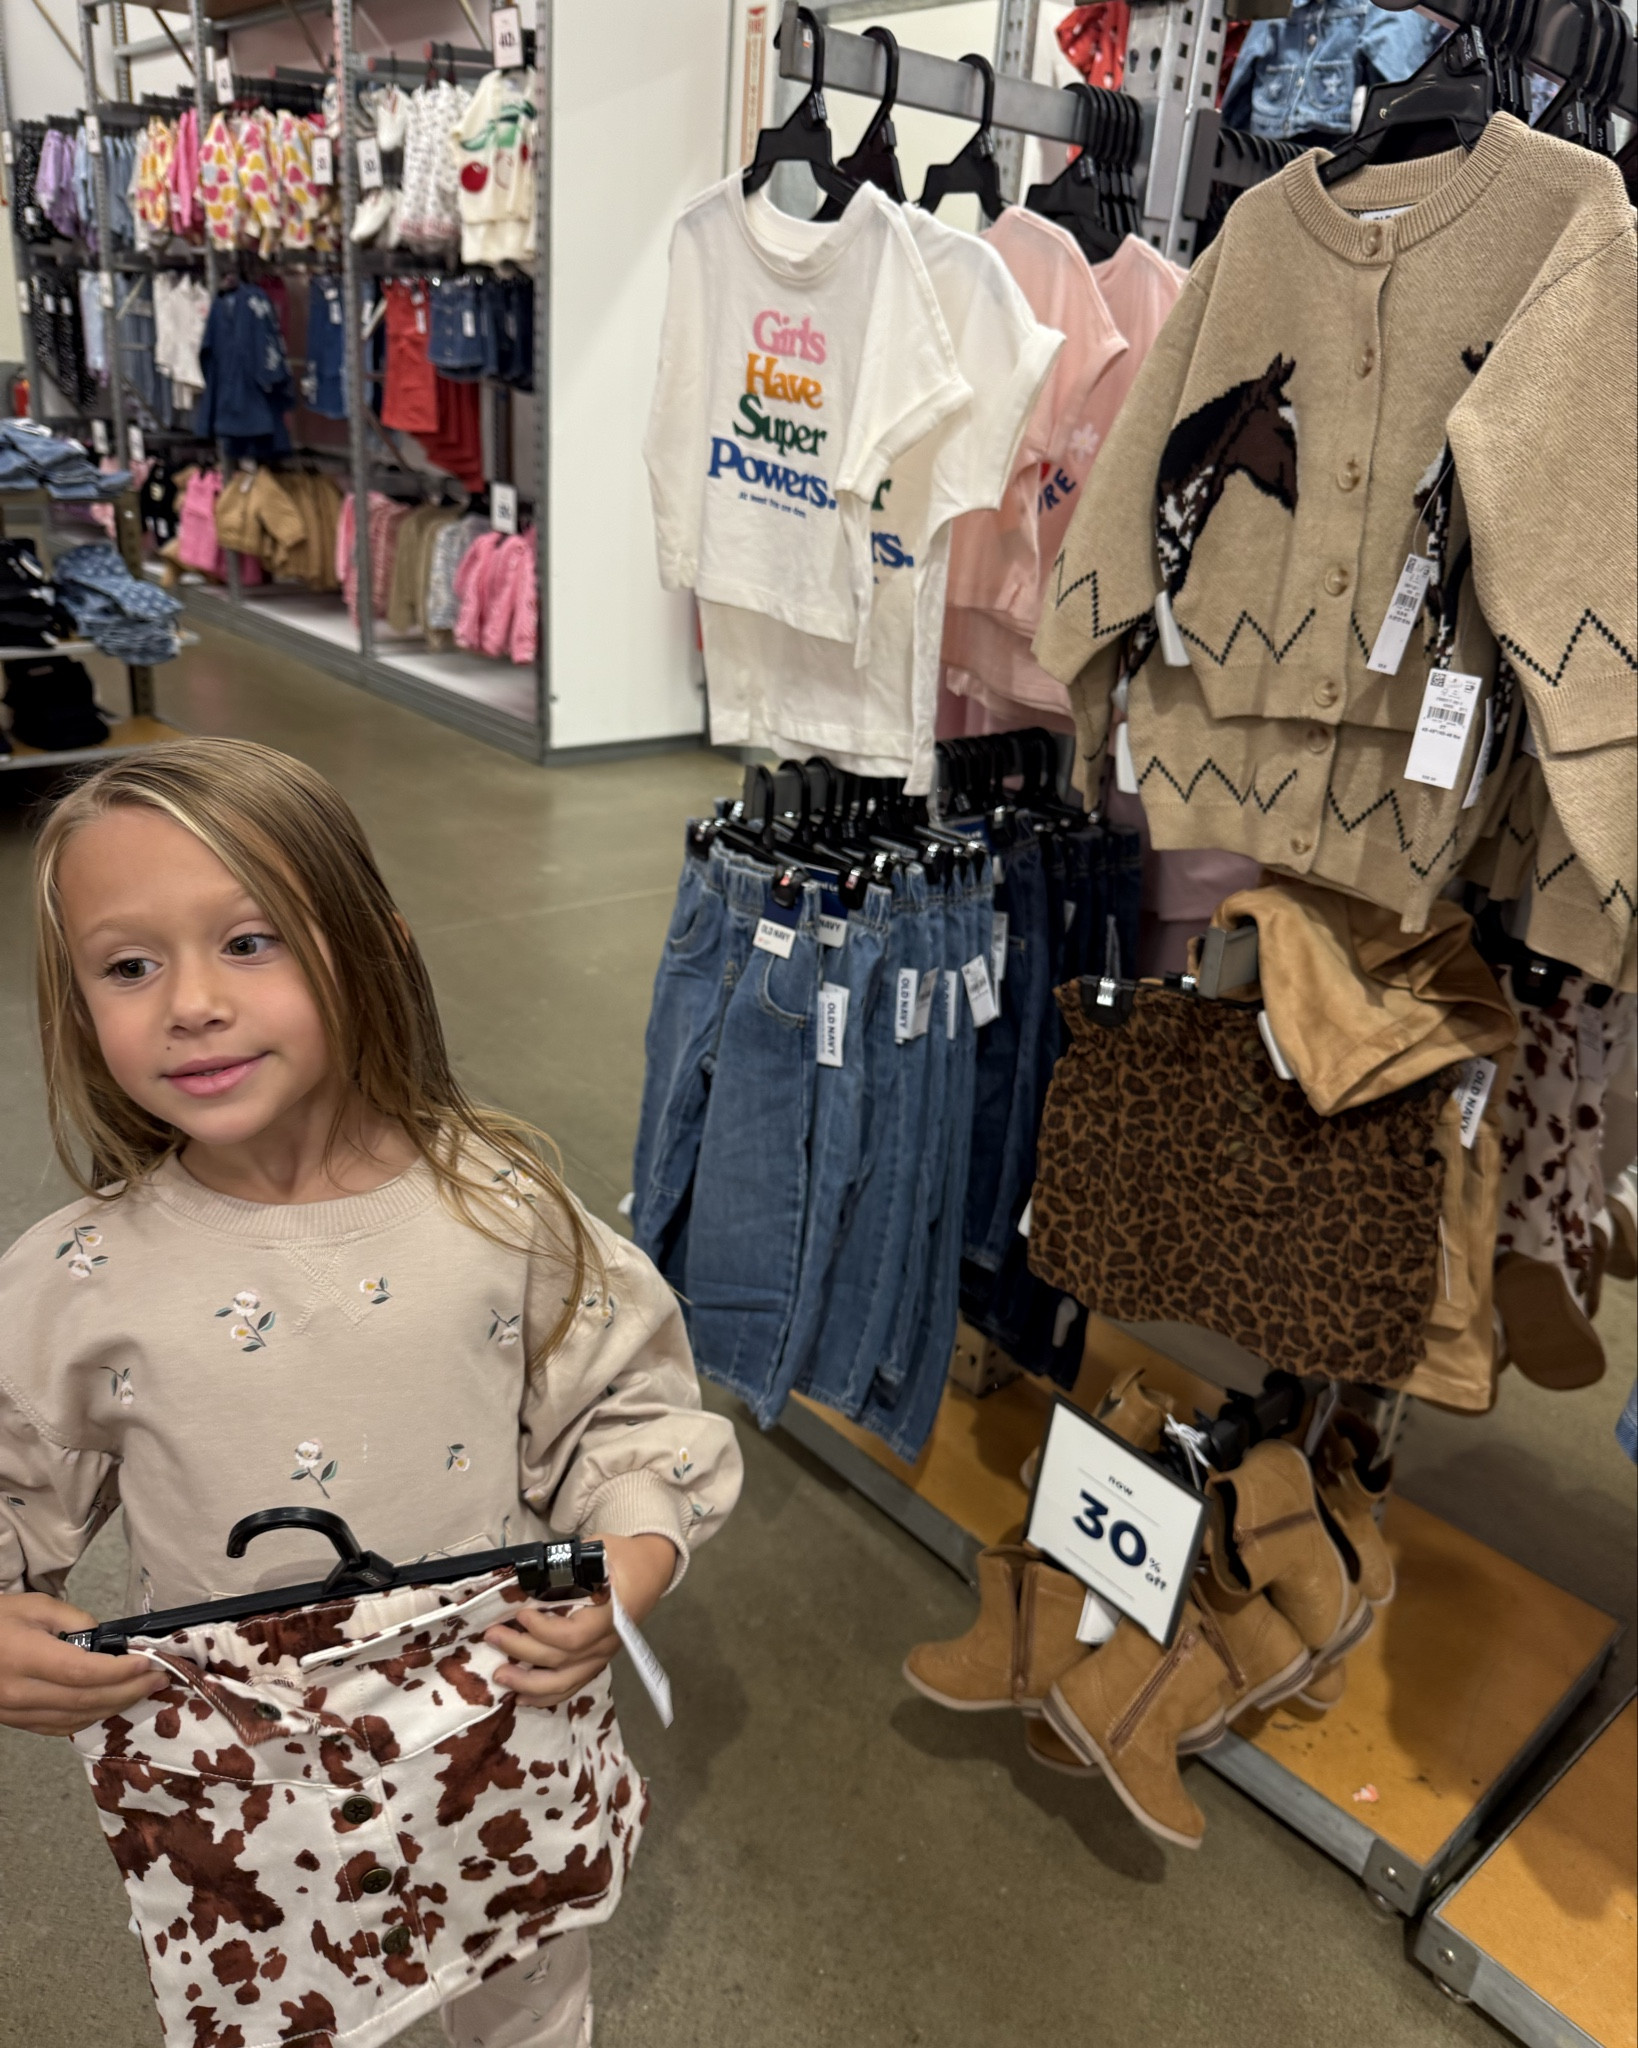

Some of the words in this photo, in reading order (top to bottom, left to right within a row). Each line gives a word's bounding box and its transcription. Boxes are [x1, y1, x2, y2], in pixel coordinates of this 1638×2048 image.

[753, 310, 827, 365] Girls
[746, 352, 823, 410] Have
[732, 394, 827, 457] Super
[707, 436, 837, 511] Powers.
[901, 977, 910, 998] OLD
[827, 1002, 836, 1023] OLD
[900, 1001, 908, 1029] NAVY
[827, 1026, 836, 1057] NAVY
[1471, 1070, 1485, 1096] OLD
[1460, 1096, 1477, 1134] NAVY
[1108, 1475, 1134, 1497] now
[1072, 1488, 1147, 1568] 30
[1145, 1572, 1168, 1592] off
